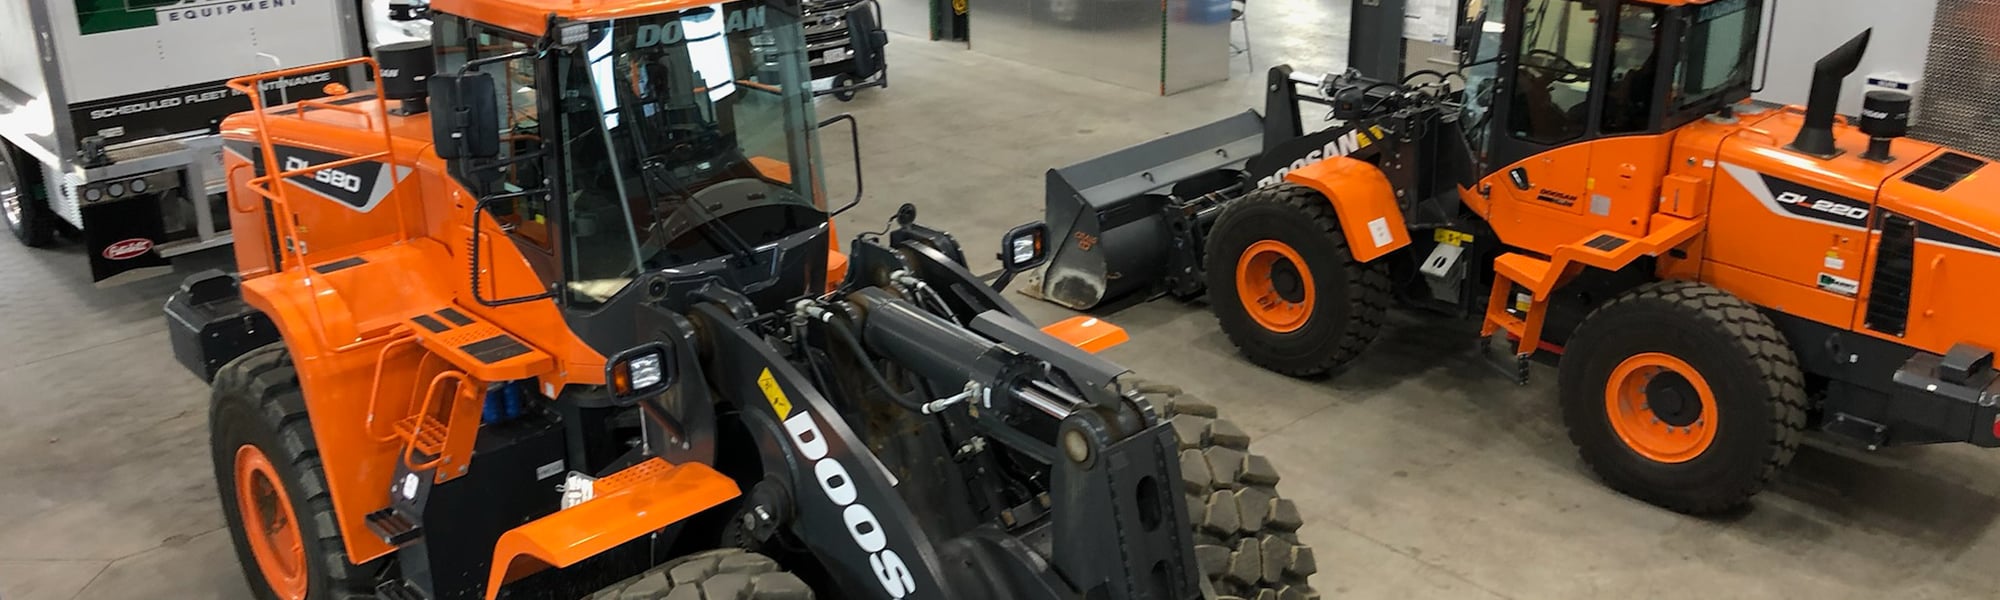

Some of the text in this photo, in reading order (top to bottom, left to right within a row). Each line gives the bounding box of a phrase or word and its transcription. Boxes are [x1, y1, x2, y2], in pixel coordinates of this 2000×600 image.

[635, 5, 767, 48] DOAN
[90, 72, 331, 119] SCHEDULED FLEET MNTENANCE
[285, 155, 361, 193] DL580
[1776, 191, 1869, 219] DL220
